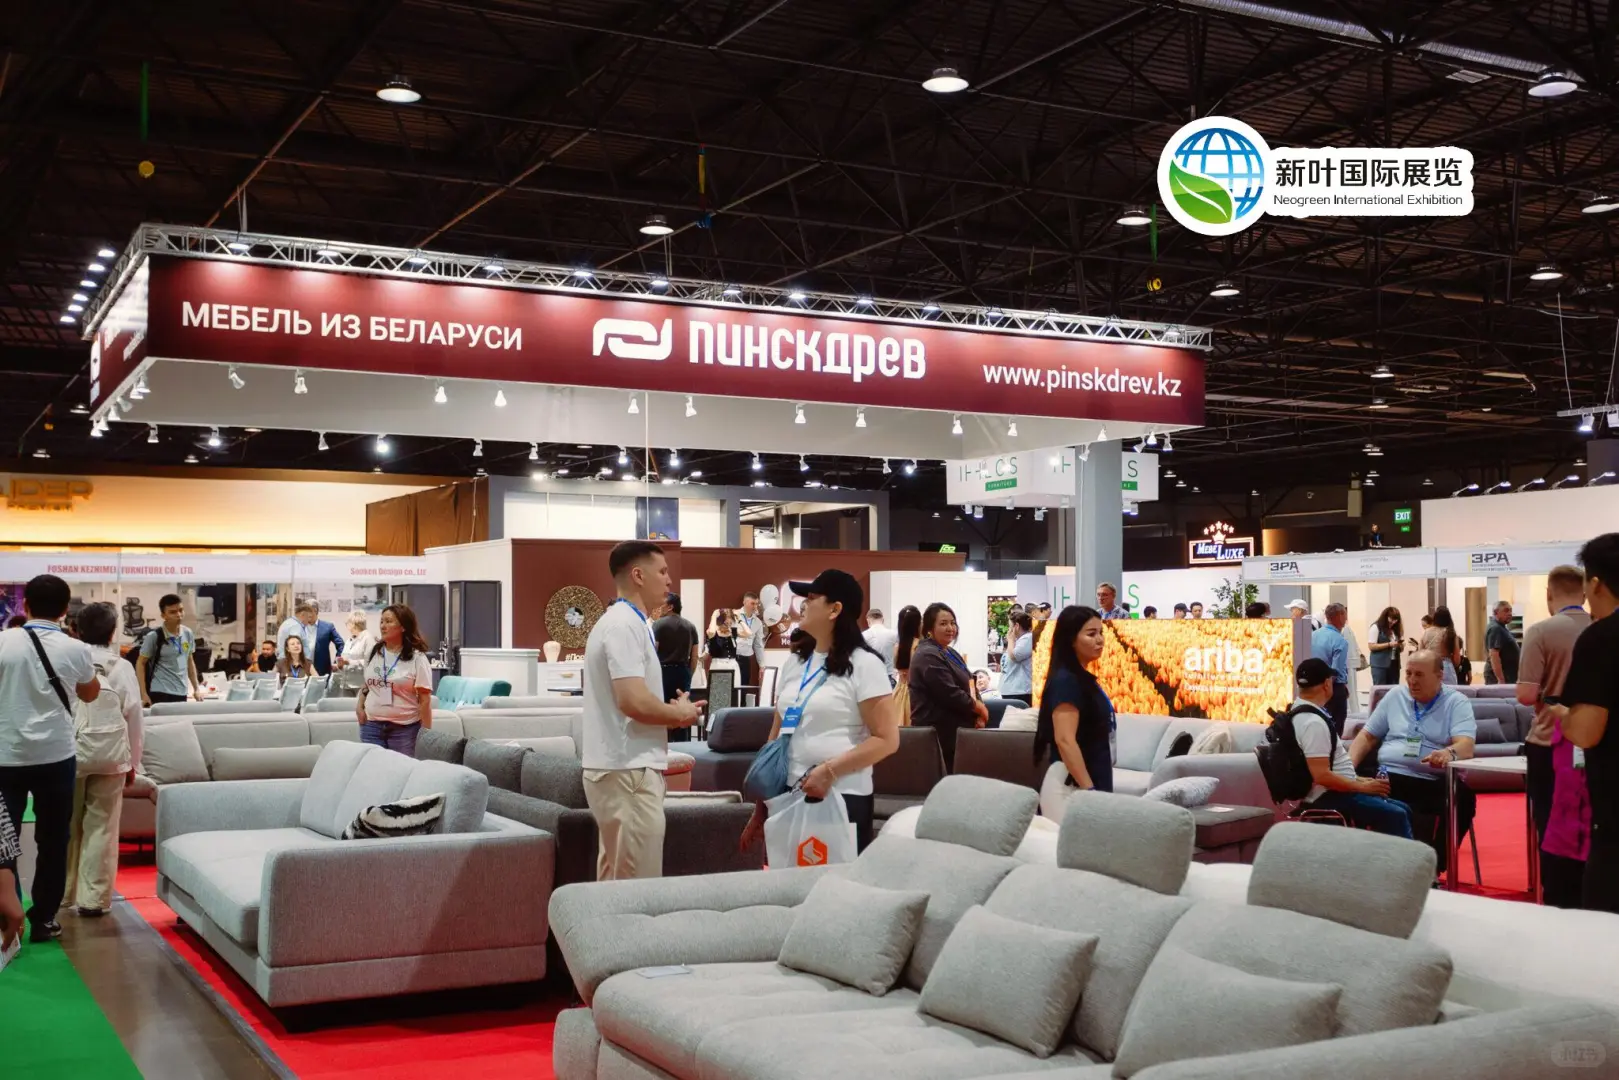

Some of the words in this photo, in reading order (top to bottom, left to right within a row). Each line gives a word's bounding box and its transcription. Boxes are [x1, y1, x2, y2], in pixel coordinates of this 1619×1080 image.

[182, 301, 312, 335] МЕБЕЛЬ
[320, 312, 361, 339] ИЗ
[369, 316, 522, 351] БЕЛАРУСИ
[983, 365, 1182, 397] www.pinskdrev.kz
[1395, 511, 1410, 520] EXIT
[47, 564, 79, 573] FOSHAN
[121, 566, 163, 575] FURNITURE
[1184, 639, 1264, 674] ariba
